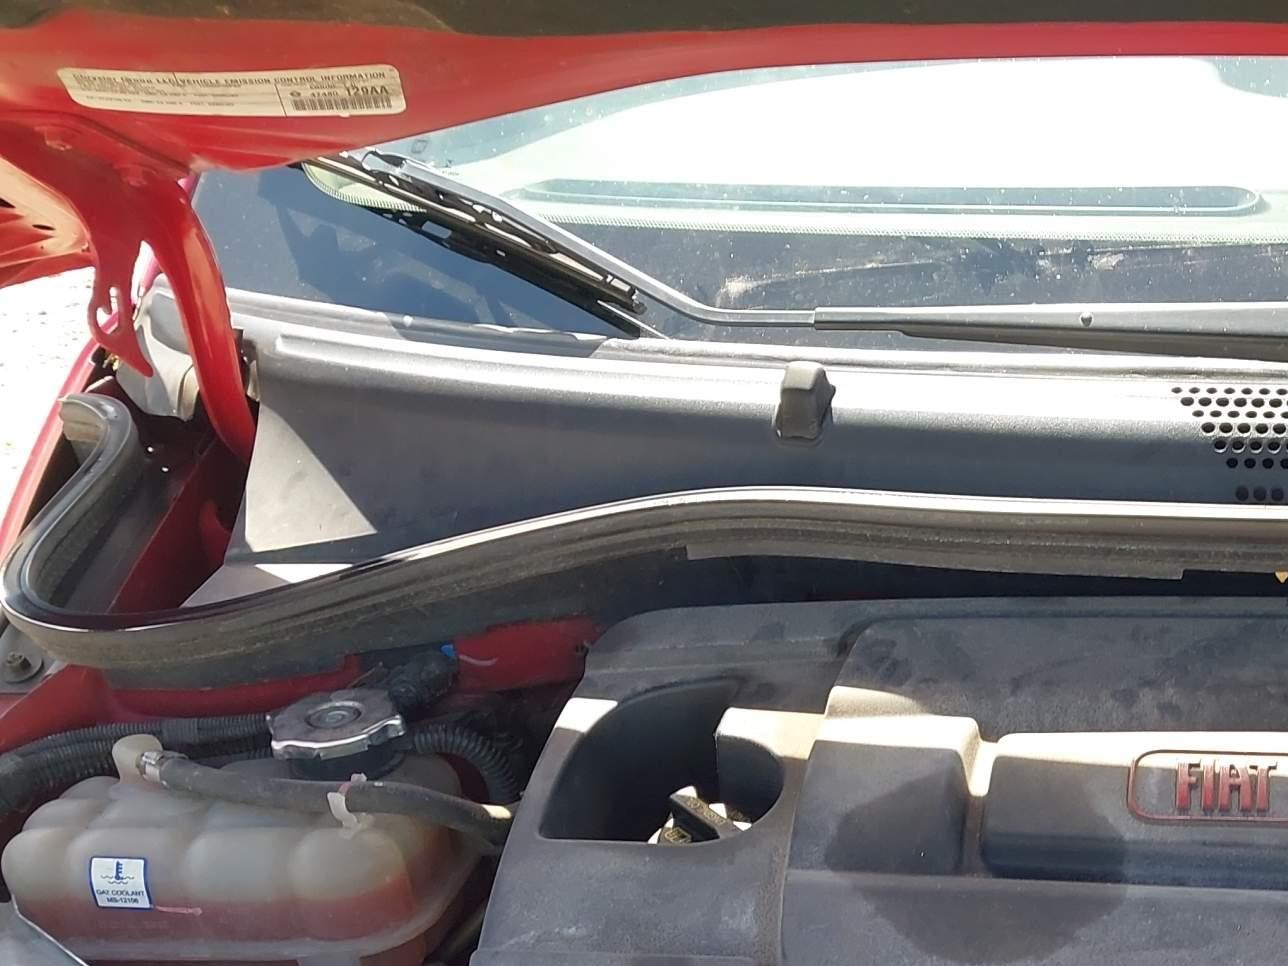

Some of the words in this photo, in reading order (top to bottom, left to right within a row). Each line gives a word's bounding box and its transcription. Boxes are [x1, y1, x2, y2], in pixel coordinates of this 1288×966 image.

[223, 77, 271, 86] EMISSION
[273, 75, 316, 84] CONTROL
[320, 71, 387, 82] INFORMATION
[1175, 759, 1279, 812] FIAT
